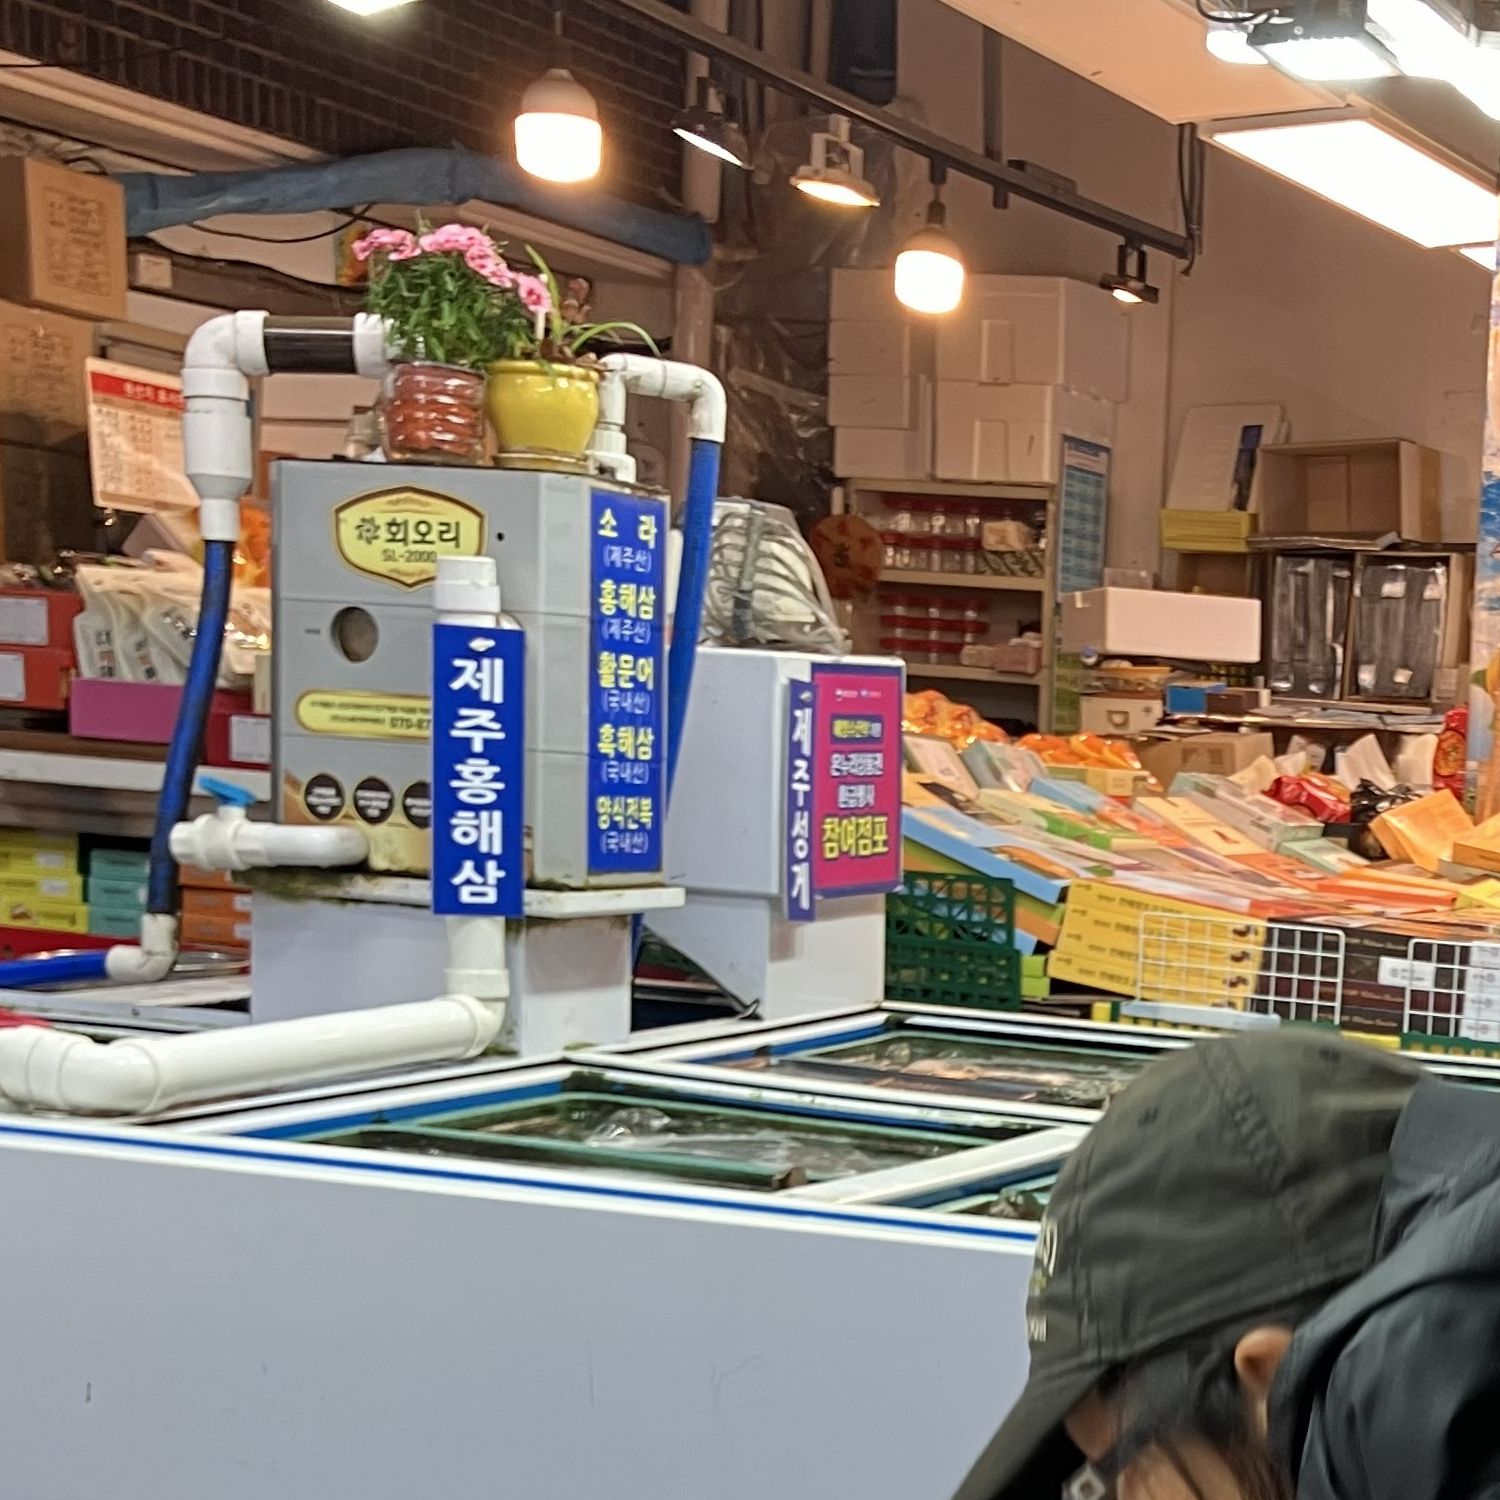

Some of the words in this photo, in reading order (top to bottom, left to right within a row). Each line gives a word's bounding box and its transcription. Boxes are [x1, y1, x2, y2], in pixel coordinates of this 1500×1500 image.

[386, 518, 460, 548] 회오리
[598, 579, 655, 620] 홍해삼
[597, 724, 655, 760] 흑해삼
[449, 657, 506, 905] 제주홍해삼
[596, 796, 653, 829] 양식전복
[822, 815, 889, 860] 참여점포
